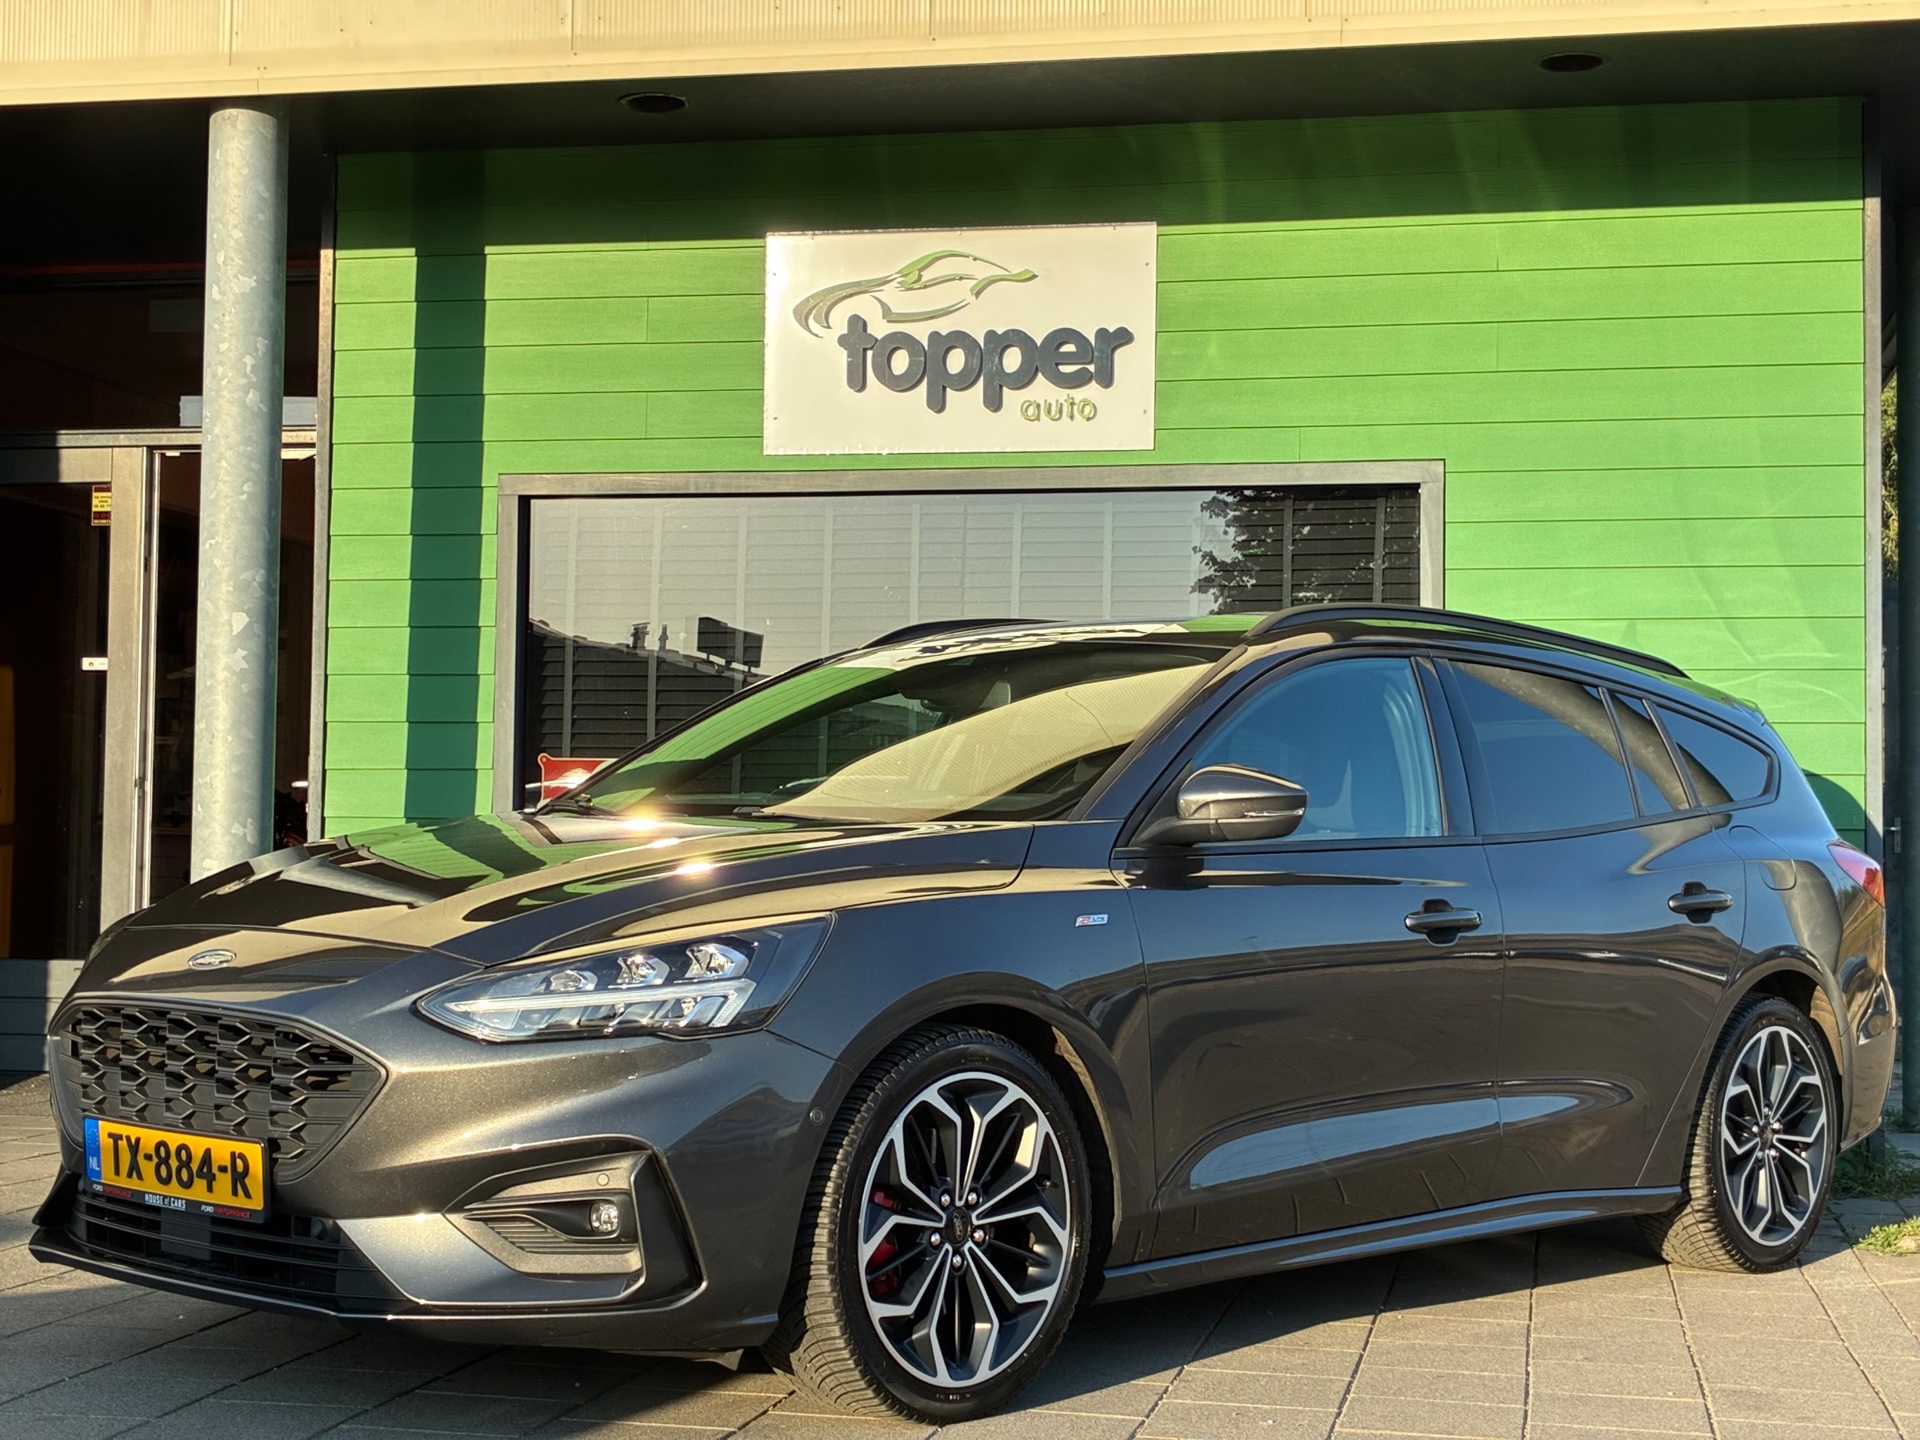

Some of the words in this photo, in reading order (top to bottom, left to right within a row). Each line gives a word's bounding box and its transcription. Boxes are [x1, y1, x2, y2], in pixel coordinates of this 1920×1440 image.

[837, 314, 1134, 412] topper
[1020, 393, 1097, 422] auto
[89, 1156, 100, 1170] NL
[107, 1132, 253, 1199] TX-884-R
[144, 1193, 164, 1205] HOUSE
[170, 1197, 186, 1209] CARS
[201, 1204, 215, 1213] FORD
